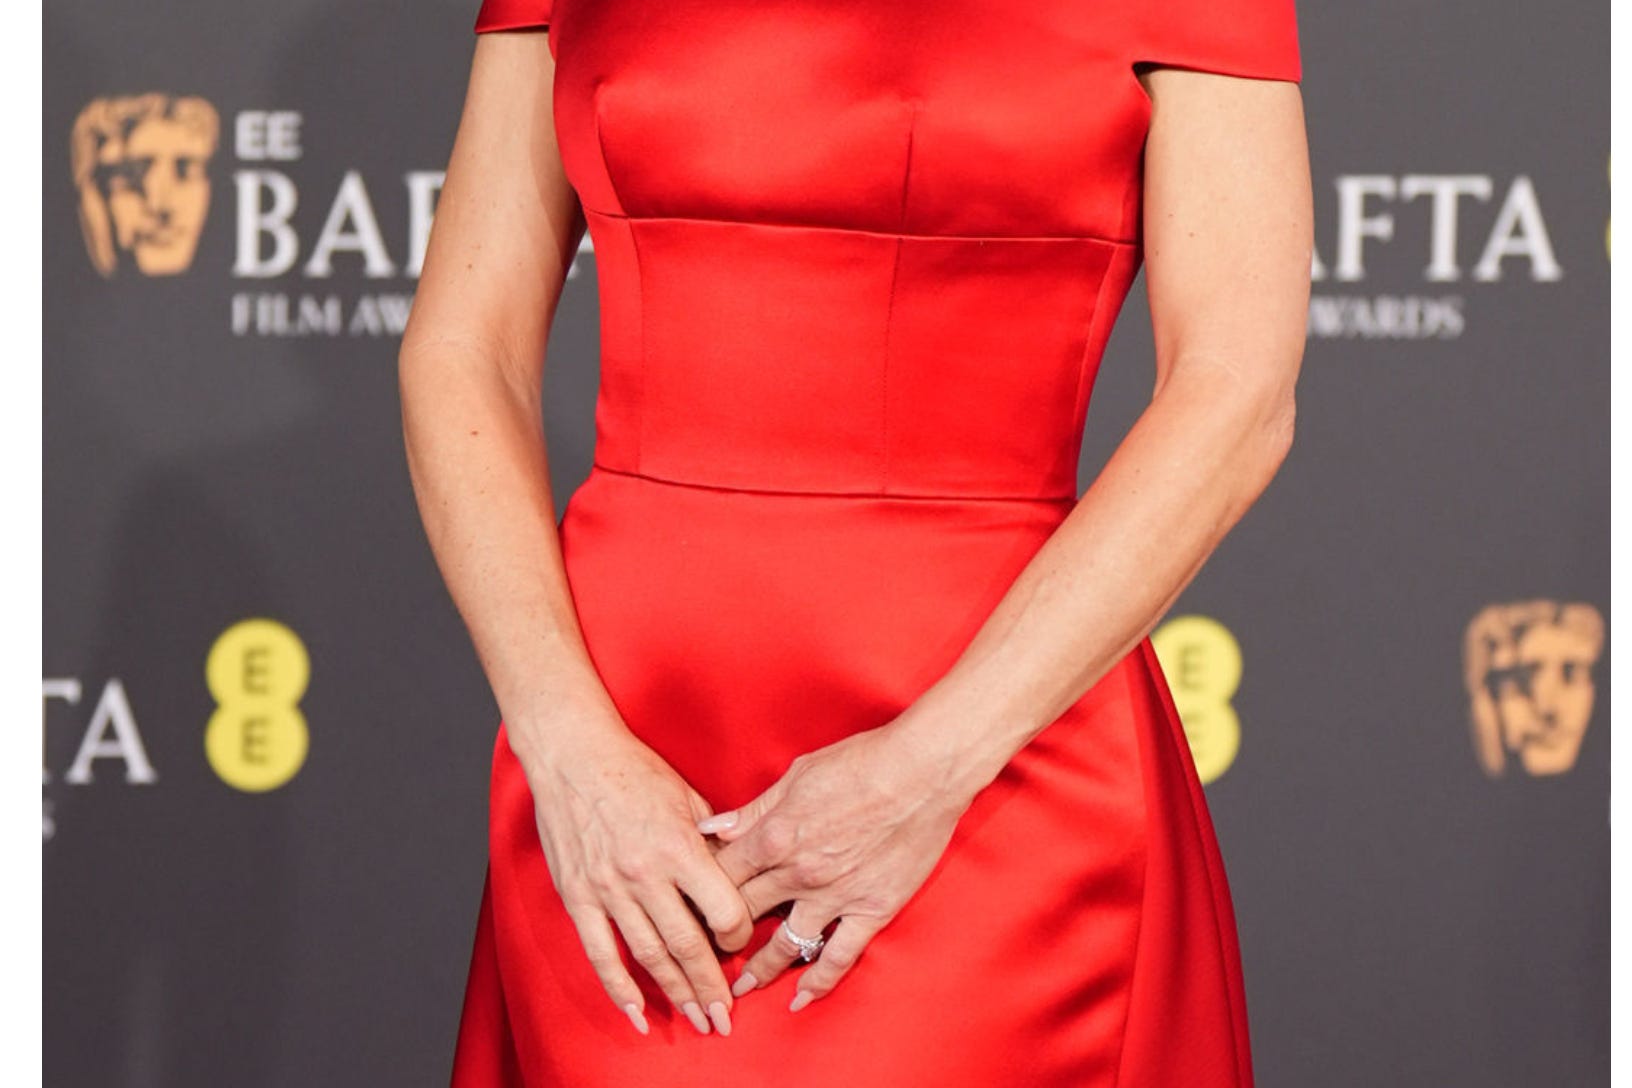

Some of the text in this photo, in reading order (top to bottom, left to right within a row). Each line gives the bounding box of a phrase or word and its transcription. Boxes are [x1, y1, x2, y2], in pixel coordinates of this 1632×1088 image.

[234, 110, 302, 162] EE
[1311, 175, 1562, 283] FTA
[230, 292, 342, 336] FILM
[1309, 293, 1466, 339] WARDS
